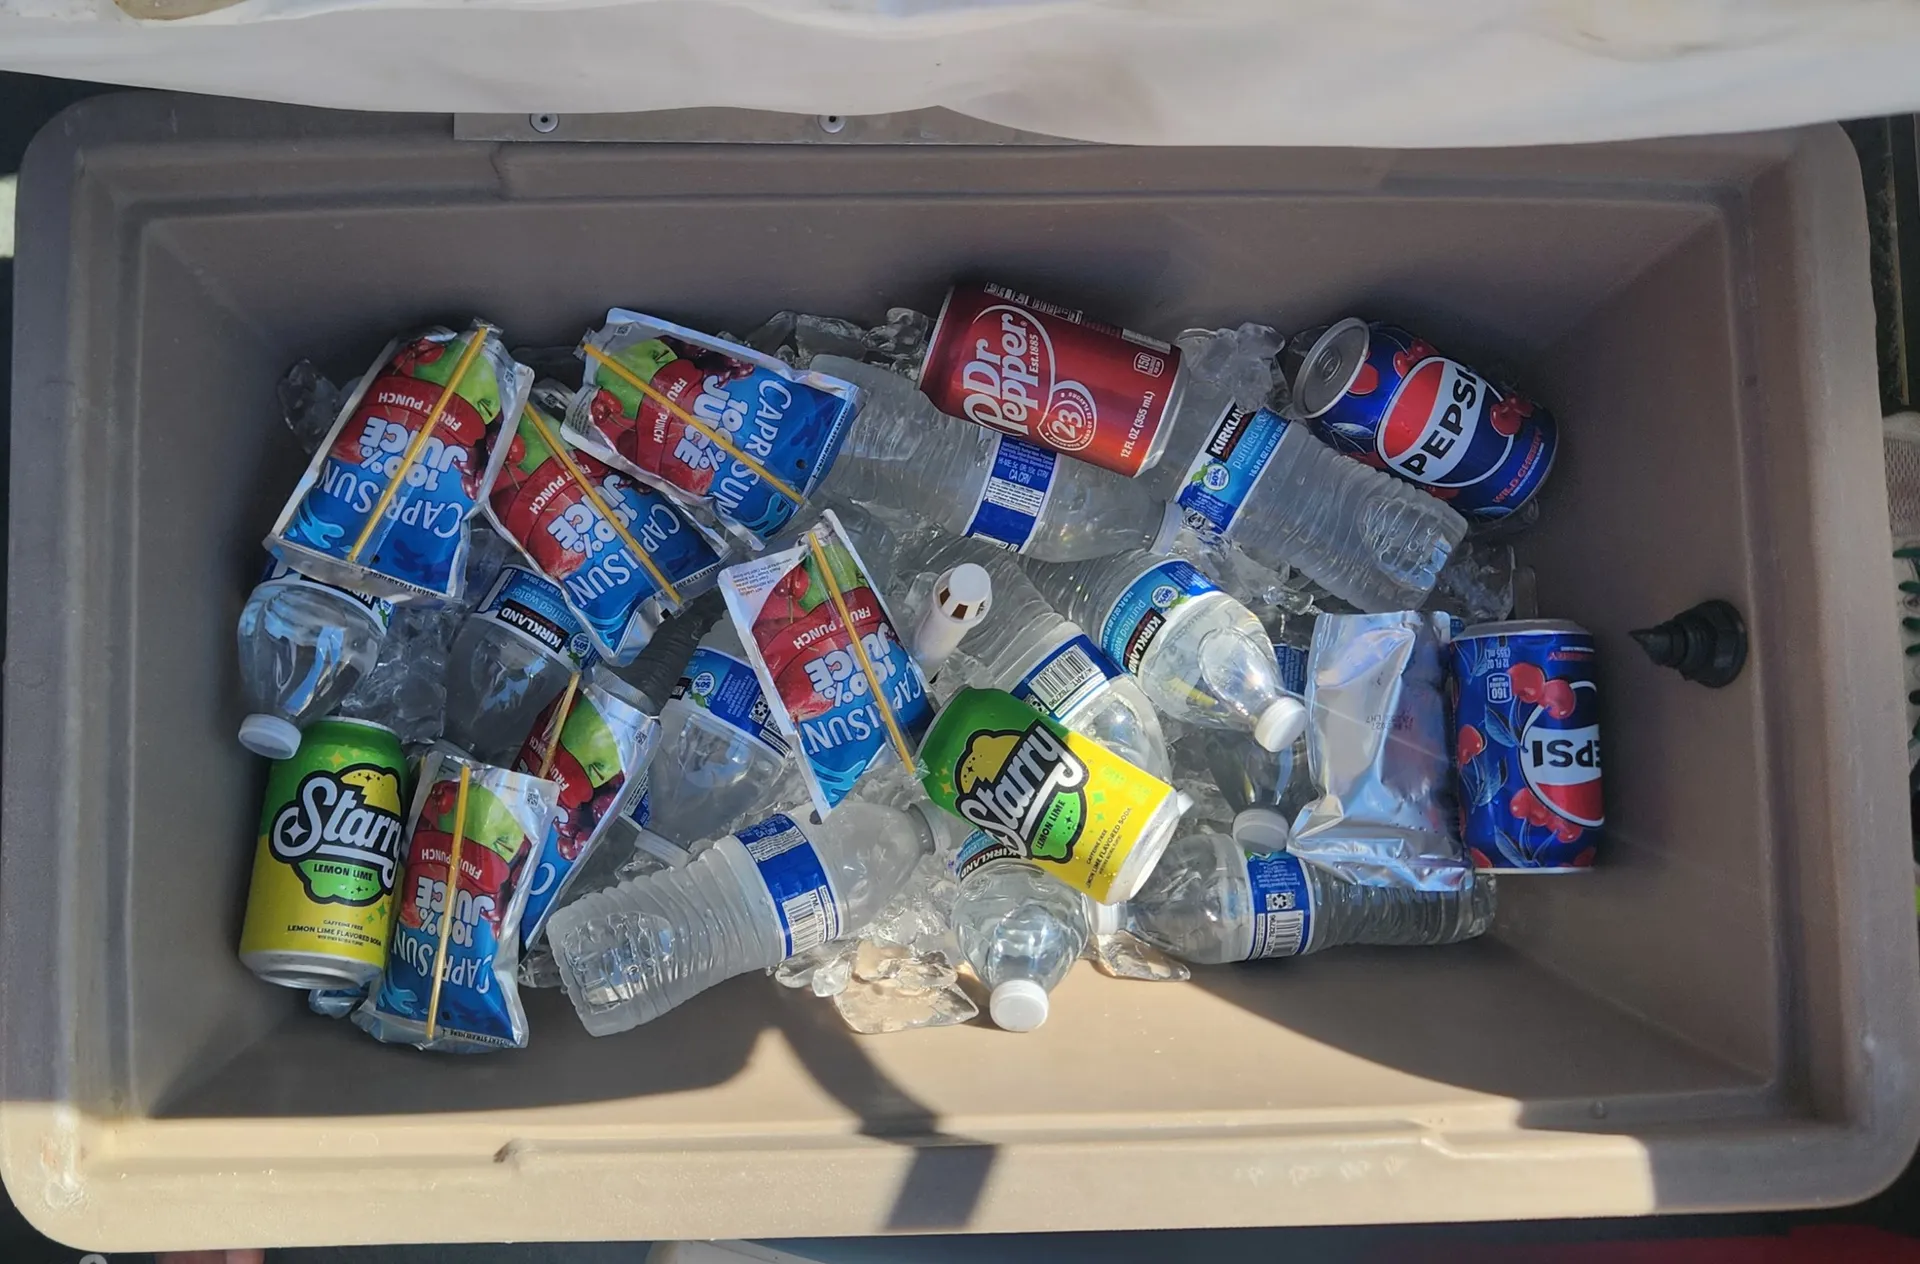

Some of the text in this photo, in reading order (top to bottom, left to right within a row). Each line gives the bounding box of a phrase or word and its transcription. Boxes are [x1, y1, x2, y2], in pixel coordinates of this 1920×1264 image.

[962, 338, 1002, 397] Dr
[963, 313, 1038, 438] Pepper
[1136, 354, 1151, 370] 150
[378, 392, 462, 432] FRUT PUNCH
[653, 377, 688, 444] FRU PUNCH
[1050, 409, 1082, 439] 23
[1120, 389, 1155, 458] 12 FL OZ (355 mL)
[1211, 407, 1246, 455] KIRKLA
[1399, 367, 1481, 477] PEPSI
[700, 397, 748, 471] 100%
[1233, 431, 1260, 470] purified
[360, 445, 442, 492] 100%
[713, 460, 761, 516] SUN
[1248, 464, 1261, 478] 16.9
[316, 460, 465, 539] CAPR SUN
[529, 476, 566, 516] PUNCH
[1493, 475, 1520, 504] WILD
[566, 504, 681, 605] CAPI SUN
[500, 607, 562, 648] KIRKLAND
[510, 587, 577, 628] purified water
[793, 606, 872, 650] FRUT PUNCH
[1120, 599, 1146, 638] purified
[1128, 616, 1161, 673] KIRKLAND
[1487, 658, 1508, 667] 12 FL OZ
[1496, 647, 1510, 657] (355
[823, 654, 896, 707] 100%
[1491, 687, 1506, 698] 160
[801, 655, 922, 753] CAPI SUN
[1532, 739, 1601, 768] EPSI
[549, 764, 570, 790] FRUI
[960, 725, 1083, 858] Starry
[1035, 798, 1066, 850] LEMON LIME
[421, 848, 484, 880] FRUI PUNCH
[961, 848, 1017, 878] KIRKLAND
[1084, 841, 1101, 864] CAFFEINE
[1090, 857, 1102, 872] LIME
[1097, 823, 1121, 858] FLAVORED
[313, 863, 373, 882] LEMON LIME
[415, 876, 496, 918] JUCE
[287, 924, 316, 933] LEMON
[316, 926, 335, 936] LIME
[336, 930, 370, 943] FLAVORED
[323, 919, 348, 929] CAFFEINE
[419, 911, 474, 948] 100%
[390, 924, 430, 974] SUN
